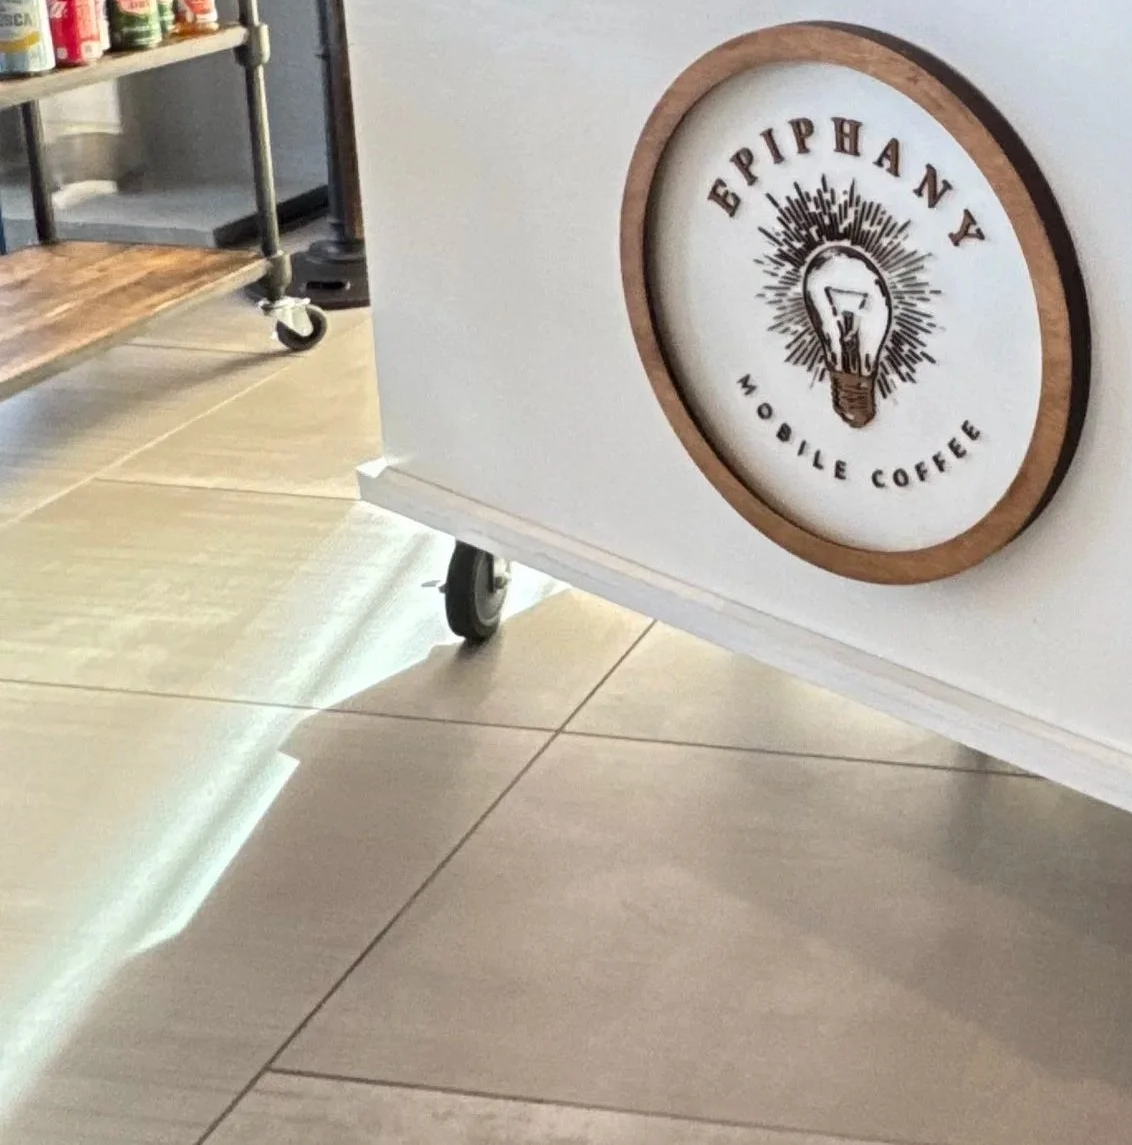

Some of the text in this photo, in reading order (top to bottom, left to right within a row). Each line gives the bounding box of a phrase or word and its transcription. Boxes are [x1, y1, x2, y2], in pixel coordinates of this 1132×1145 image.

[706, 116, 986, 248] EPIPHANY
[736, 372, 982, 490] MOBILE COFFEE
